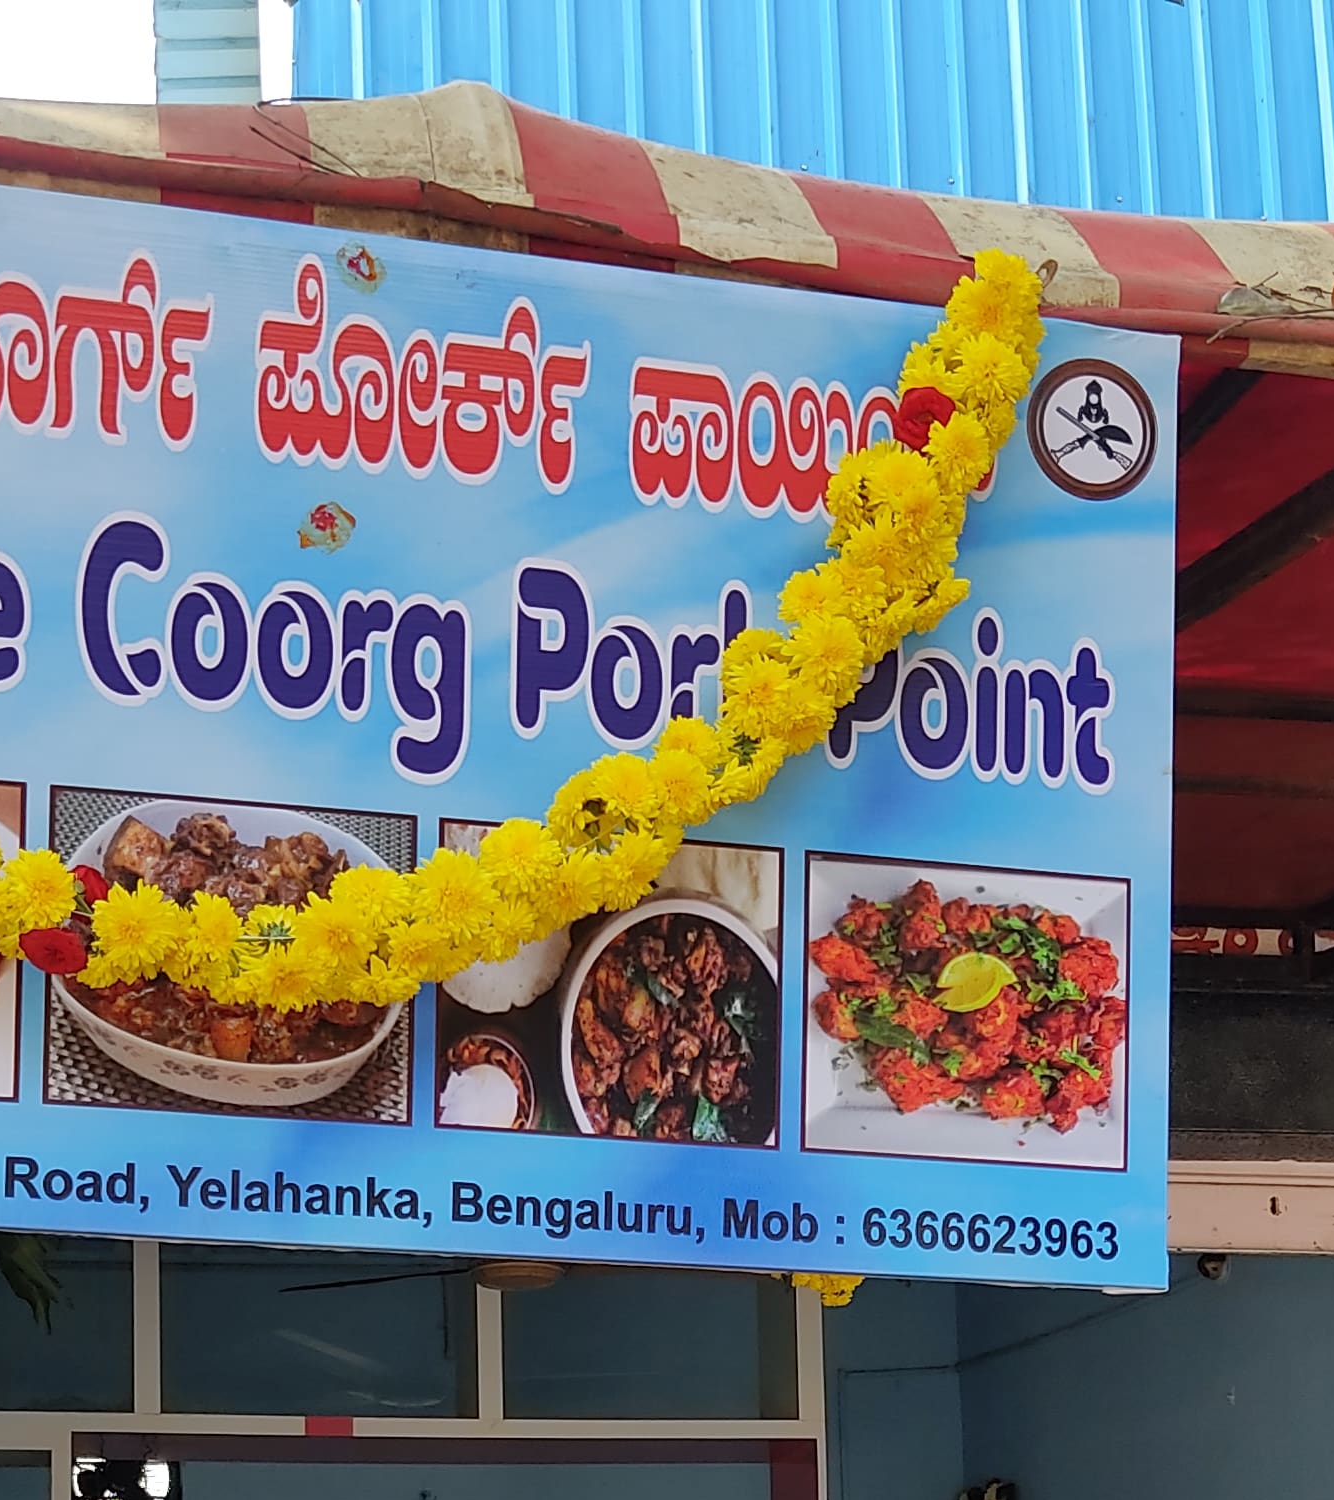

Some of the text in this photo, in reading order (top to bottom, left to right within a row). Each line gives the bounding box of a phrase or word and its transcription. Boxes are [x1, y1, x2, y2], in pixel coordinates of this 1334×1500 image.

[79, 519, 468, 776] Coorg
[3, 1156, 150, 1214] Road,
[166, 1164, 434, 1229] Yelahanka,
[451, 1181, 705, 1246] Bengaluru,
[722, 1198, 819, 1243] Mob
[862, 1208, 1119, 1260] 6366623963
